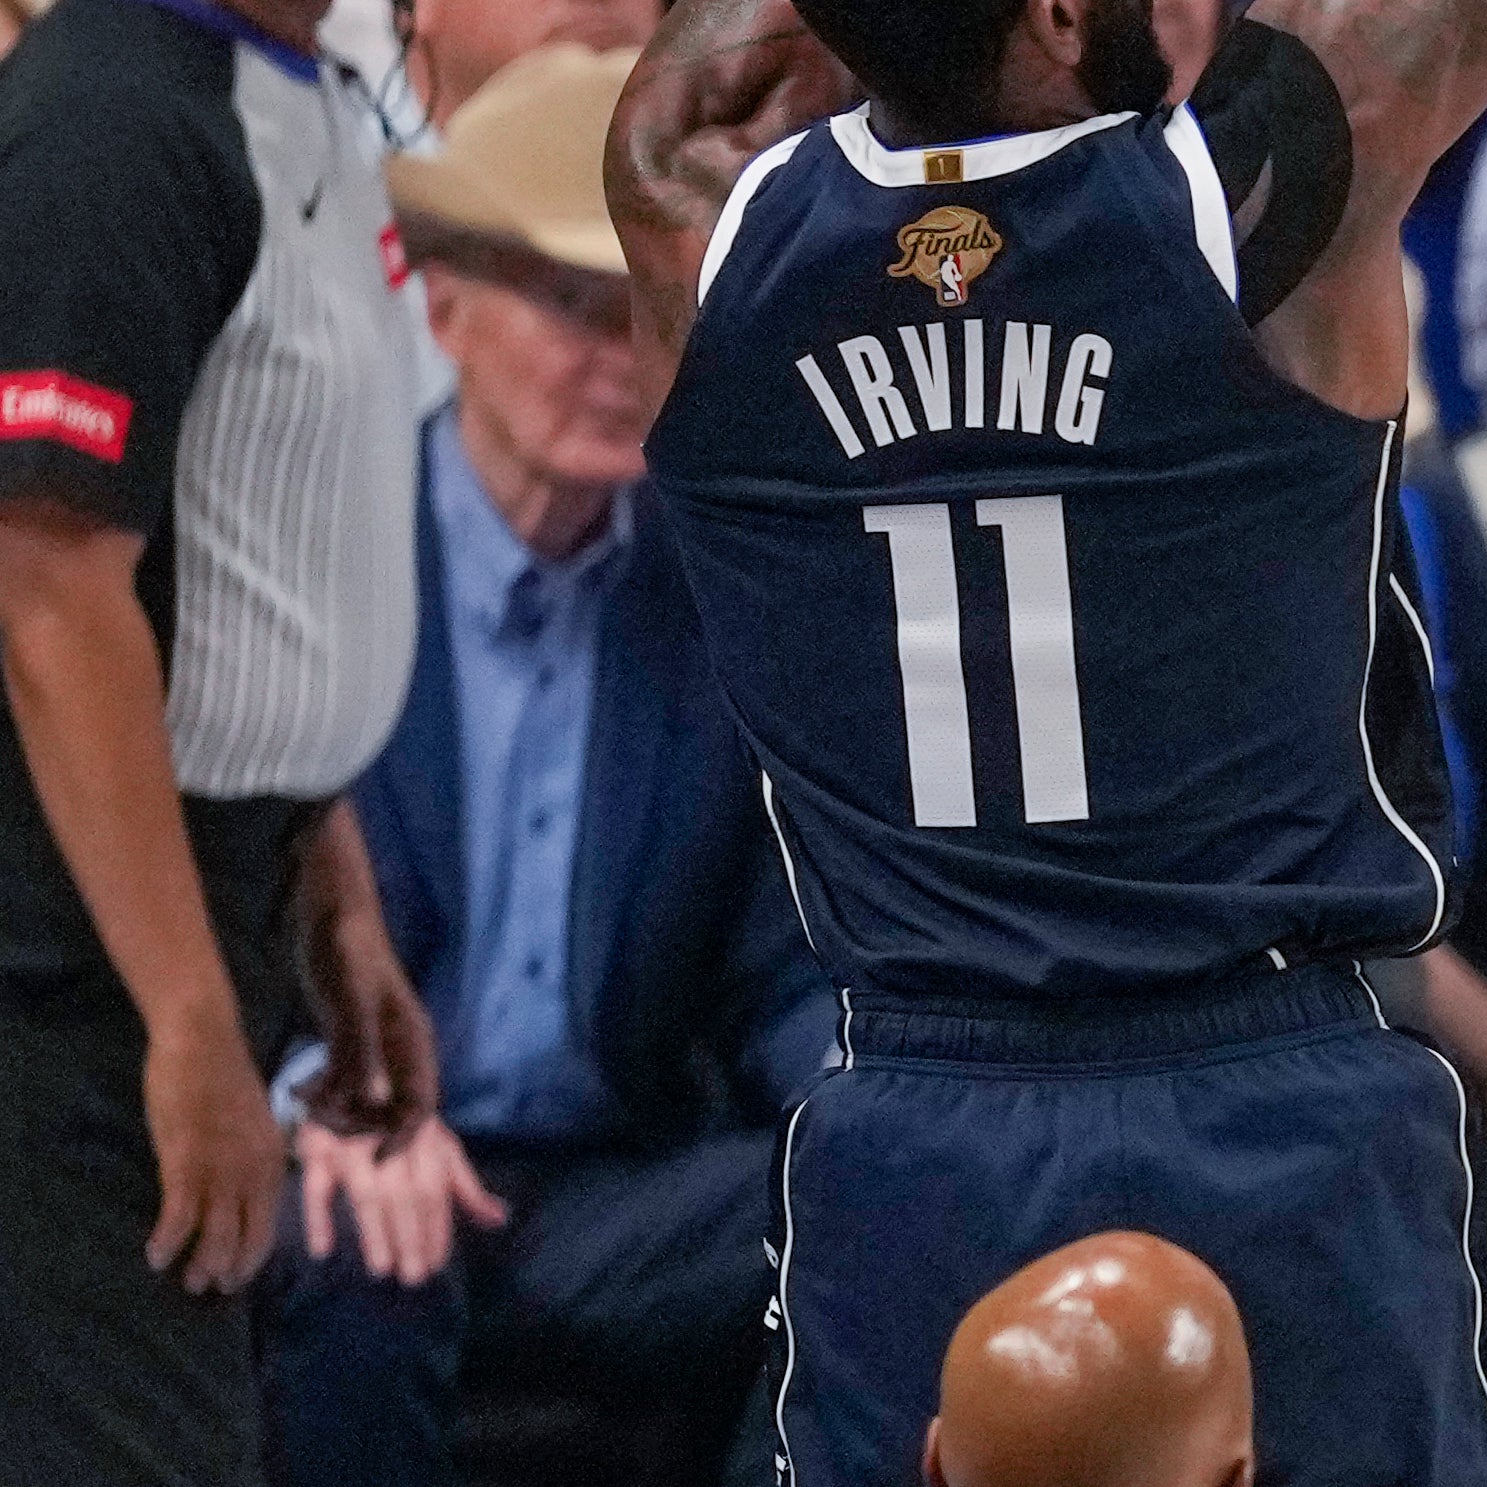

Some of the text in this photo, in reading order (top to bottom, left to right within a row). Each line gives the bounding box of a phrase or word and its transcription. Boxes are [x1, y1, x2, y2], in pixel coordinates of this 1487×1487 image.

[892, 218, 997, 273] Finals
[795, 318, 1114, 460] IRVING
[862, 494, 1090, 828] 11
